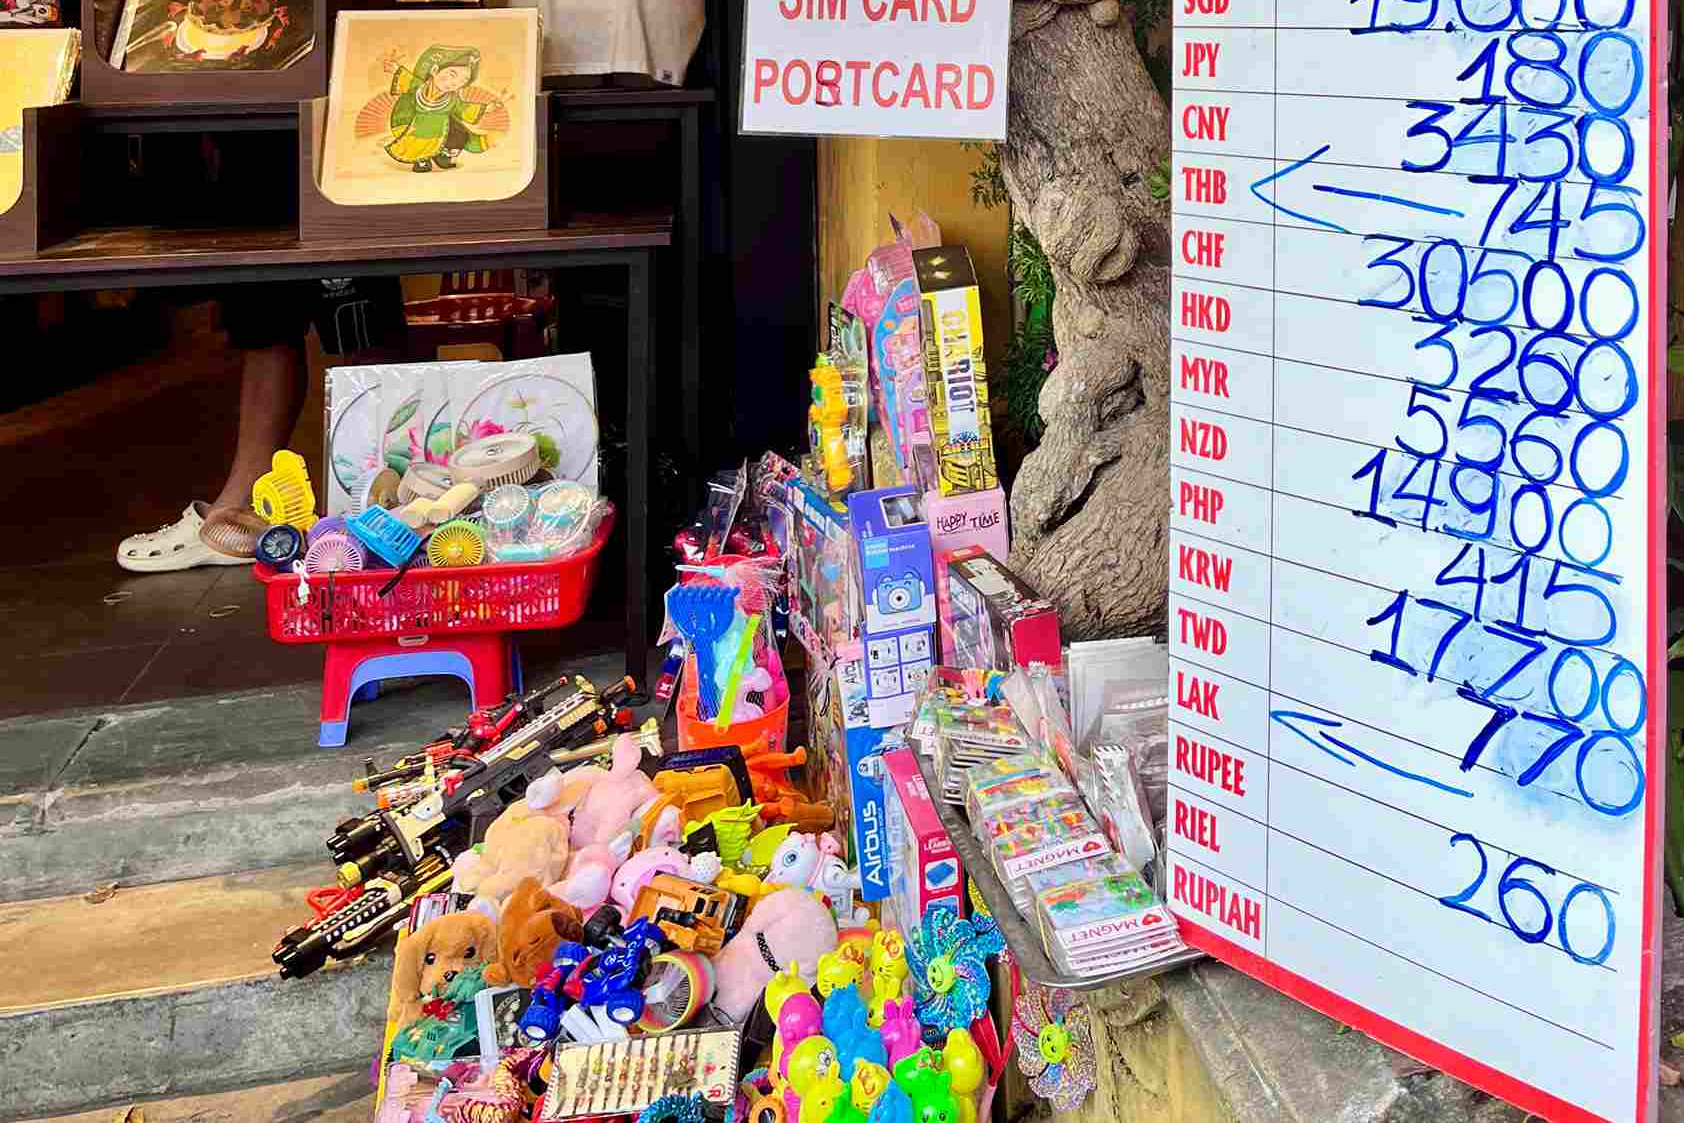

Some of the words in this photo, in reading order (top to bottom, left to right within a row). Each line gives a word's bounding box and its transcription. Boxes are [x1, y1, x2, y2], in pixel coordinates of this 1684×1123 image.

[1181, 42, 1221, 79] JPY
[1455, 30, 1644, 118] 180
[1182, 104, 1231, 141] CNY
[1401, 100, 1635, 184] 3430
[1182, 166, 1228, 205] THB
[1467, 175, 1647, 262] 745
[1182, 229, 1226, 269] CHF
[1181, 291, 1232, 332] HKD
[1180, 354, 1231, 399] MYR
[1410, 315, 1640, 422] 3260
[1179, 417, 1229, 462] NZD
[1394, 384, 1630, 500] 5560
[936, 510, 968, 532] HAPPY
[970, 511, 1001, 528] TIME
[1179, 480, 1224, 526] PHP
[1351, 447, 1613, 569] 14900
[1178, 544, 1233, 594] KRW
[1434, 541, 1623, 647] 415
[1176, 607, 1228, 658] TWD
[1366, 587, 1648, 737] 17700
[1175, 670, 1221, 721] LAK
[1174, 734, 1247, 799] RUPEE
[1456, 680, 1647, 817] 770
[1173, 799, 1222, 855] RIEL
[1014, 844, 1082, 874] MAGNET
[1172, 862, 1263, 943] RUPIAH
[1439, 832, 1617, 966] 260
[1071, 917, 1138, 942] MAGNET
